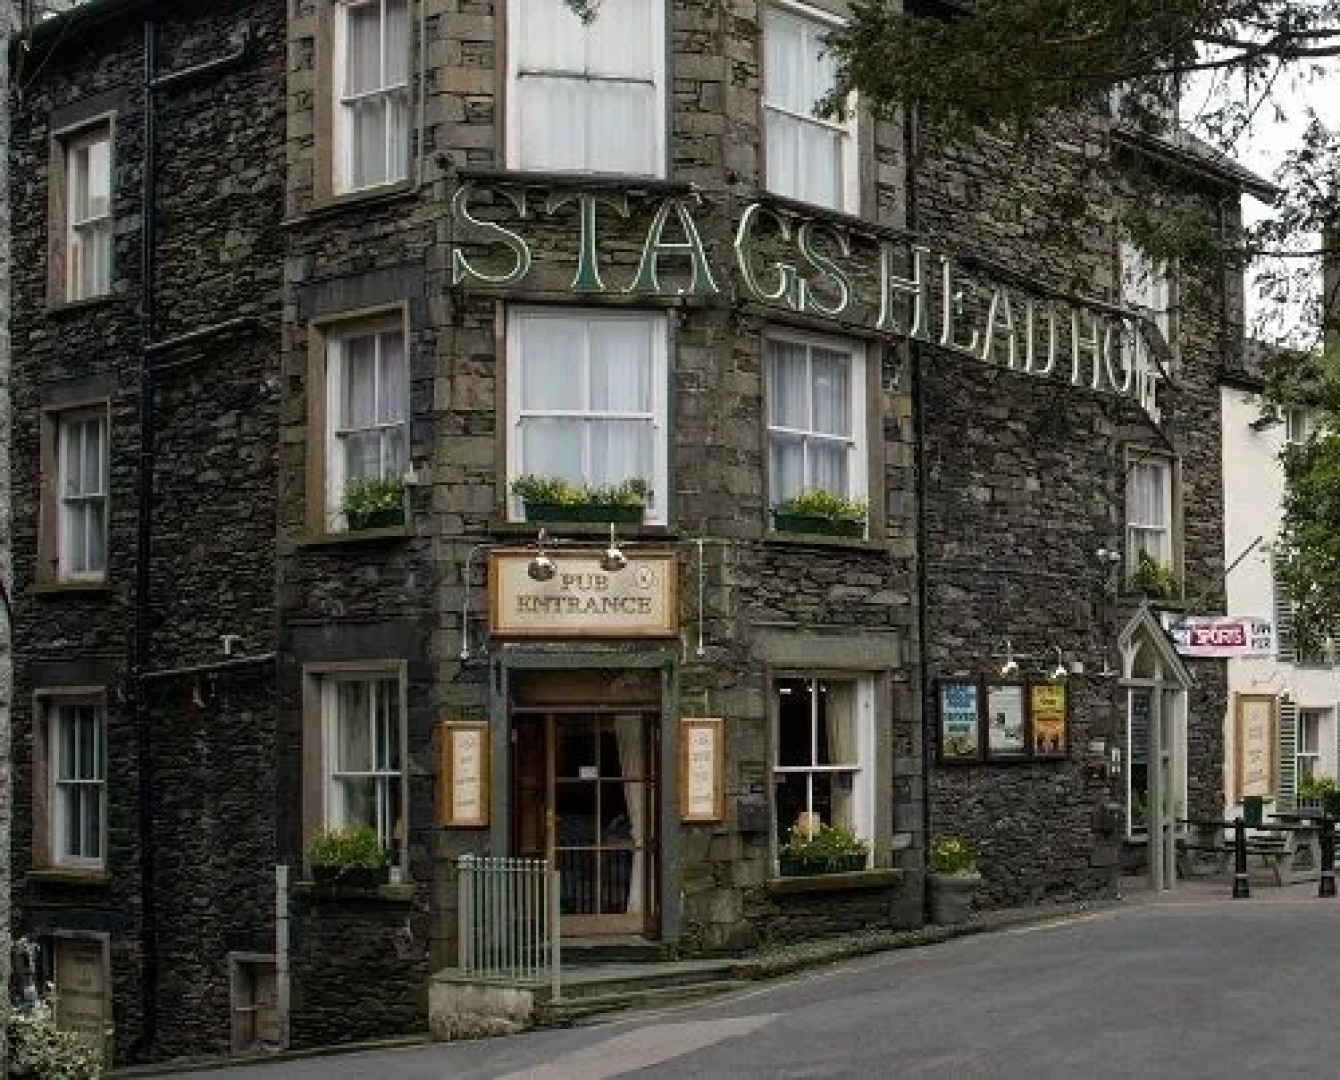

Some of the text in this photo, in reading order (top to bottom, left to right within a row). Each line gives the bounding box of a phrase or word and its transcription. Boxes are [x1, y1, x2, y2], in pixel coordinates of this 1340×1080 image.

[452, 184, 854, 314] STAGS
[876, 242, 1057, 376] HEAD
[559, 573, 609, 591] PUB
[516, 595, 652, 614] ENTRANCE
